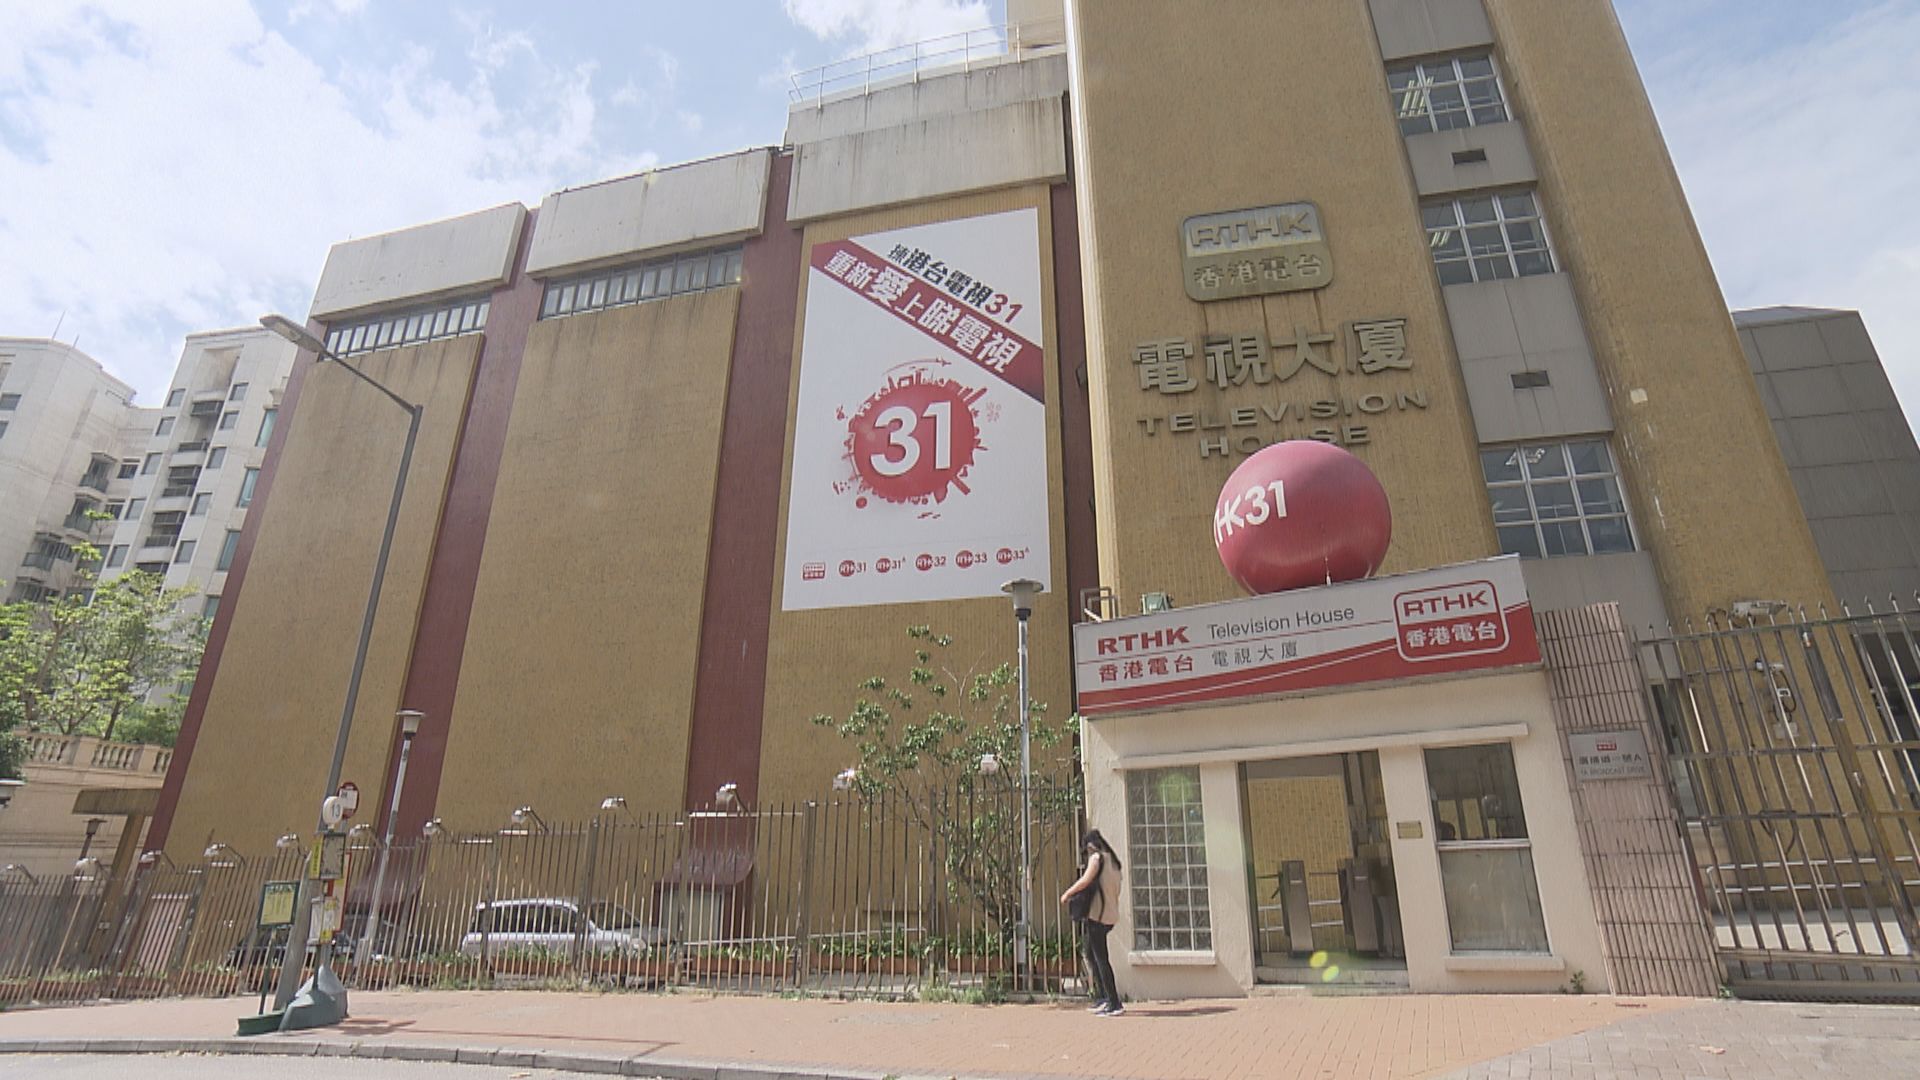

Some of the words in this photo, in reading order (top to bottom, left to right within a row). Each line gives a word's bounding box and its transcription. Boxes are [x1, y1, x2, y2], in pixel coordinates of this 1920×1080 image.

[1190, 212, 1312, 247] RTHK
[1194, 254, 1322, 289] 香港電台
[824, 250, 1022, 373] 重新愛上睇電視
[1137, 390, 1428, 436] TELEVISION
[870, 401, 951, 476] 31
[1201, 426, 1371, 458] HOSE
[1403, 590, 1488, 617] RTHK
[1208, 615, 1290, 640] Television
[1295, 607, 1355, 628] House
[1406, 620, 1497, 649] 香港電台
[1097, 626, 1190, 655] RTHK
[1098, 654, 1193, 683] 香港電台
